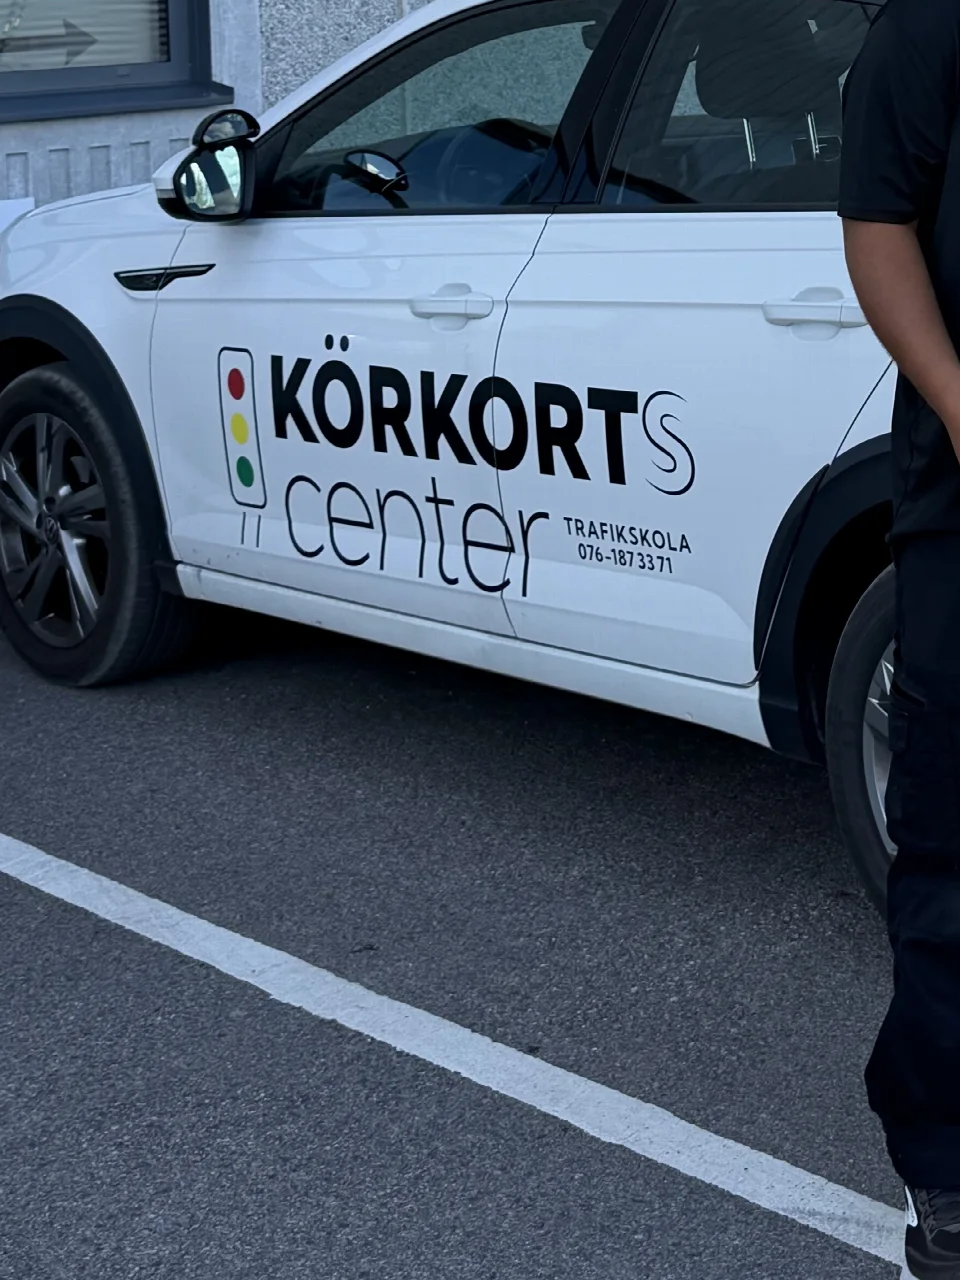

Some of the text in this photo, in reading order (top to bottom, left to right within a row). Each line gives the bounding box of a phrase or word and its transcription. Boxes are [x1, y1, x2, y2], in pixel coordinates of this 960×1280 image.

[270, 333, 696, 496] KÖRKORTS
[284, 474, 550, 597] center
[563, 516, 692, 554] TRAFIKSKOLA
